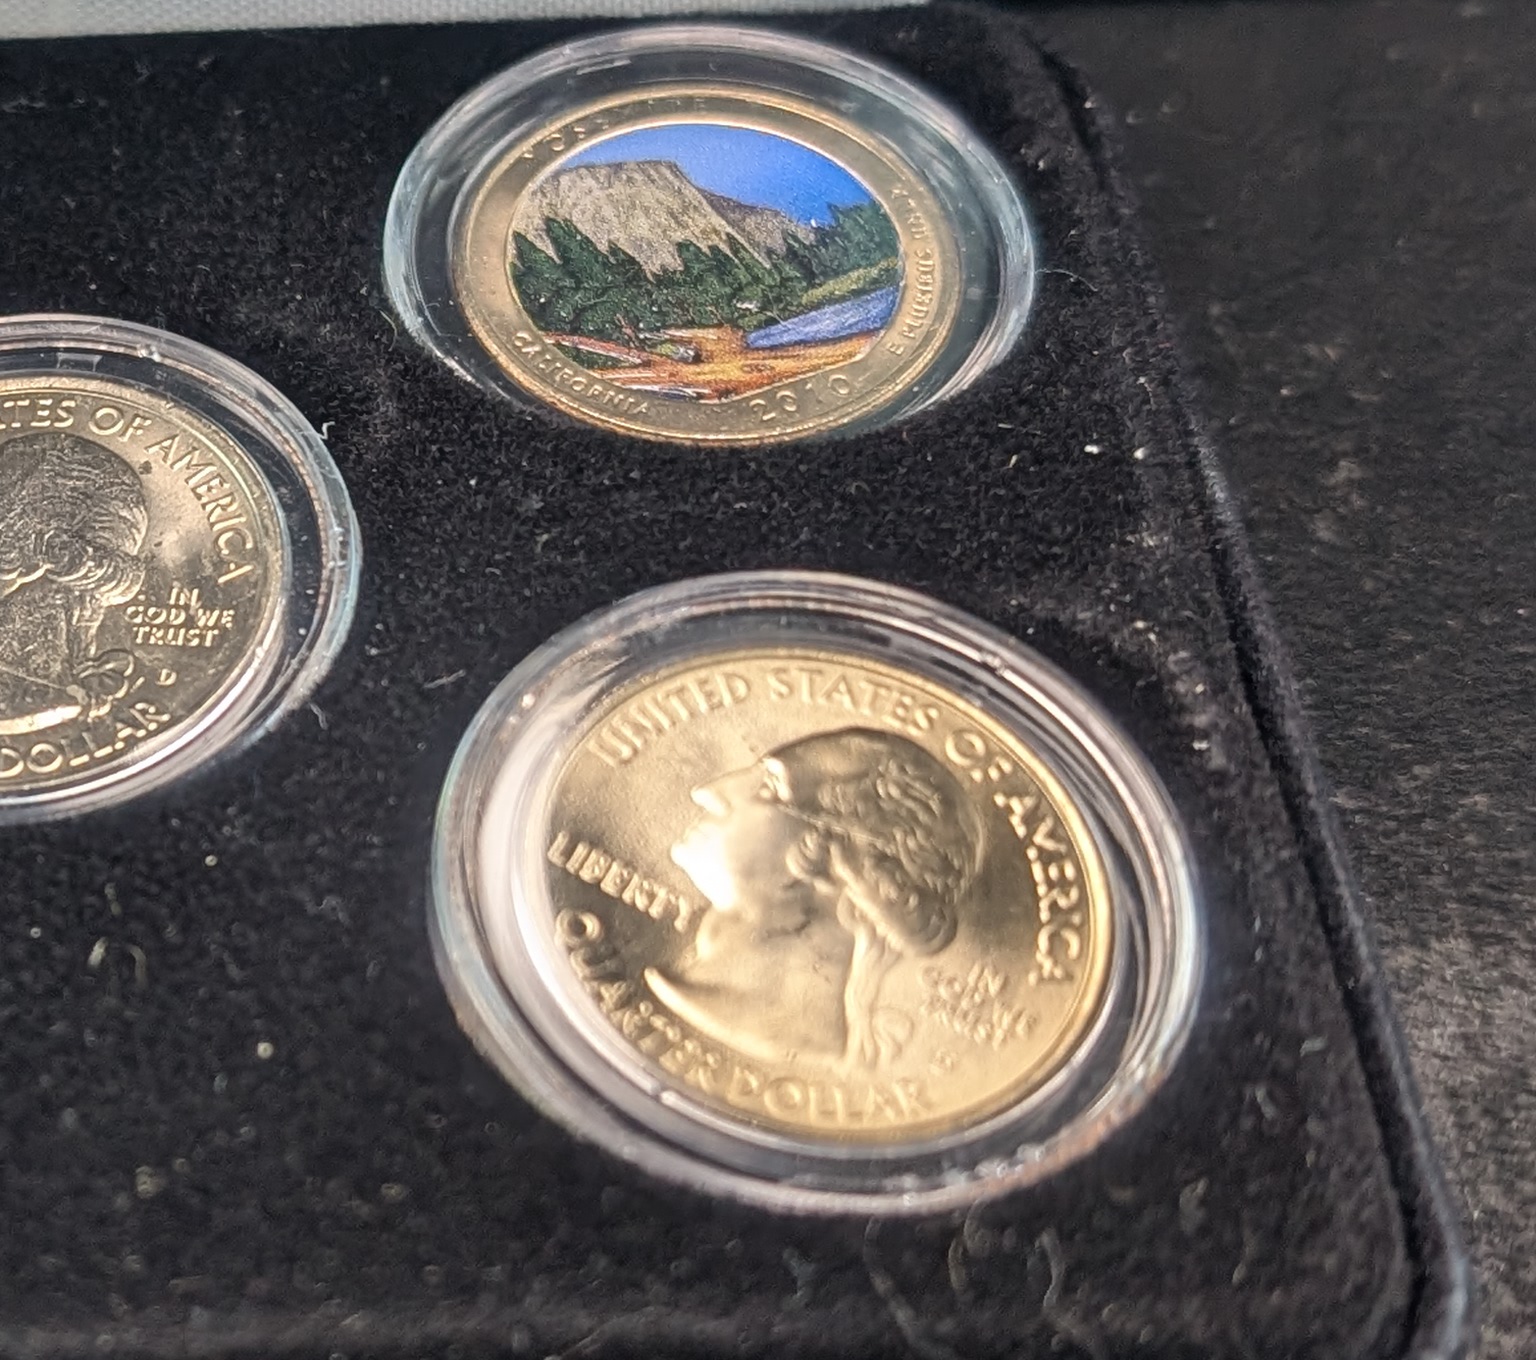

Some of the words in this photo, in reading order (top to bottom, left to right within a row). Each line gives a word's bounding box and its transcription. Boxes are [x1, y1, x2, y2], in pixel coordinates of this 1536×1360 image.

[88, 405, 154, 440] OF
[147, 435, 255, 585] AMERICA
[124, 605, 186, 626] GOD
[197, 607, 235, 630] WE
[167, 586, 202, 607] IN
[132, 625, 220, 648] TRUST
[588, 673, 750, 767] UNITED
[768, 669, 940, 734] STATES
[547, 831, 691, 933] LIBERTY
